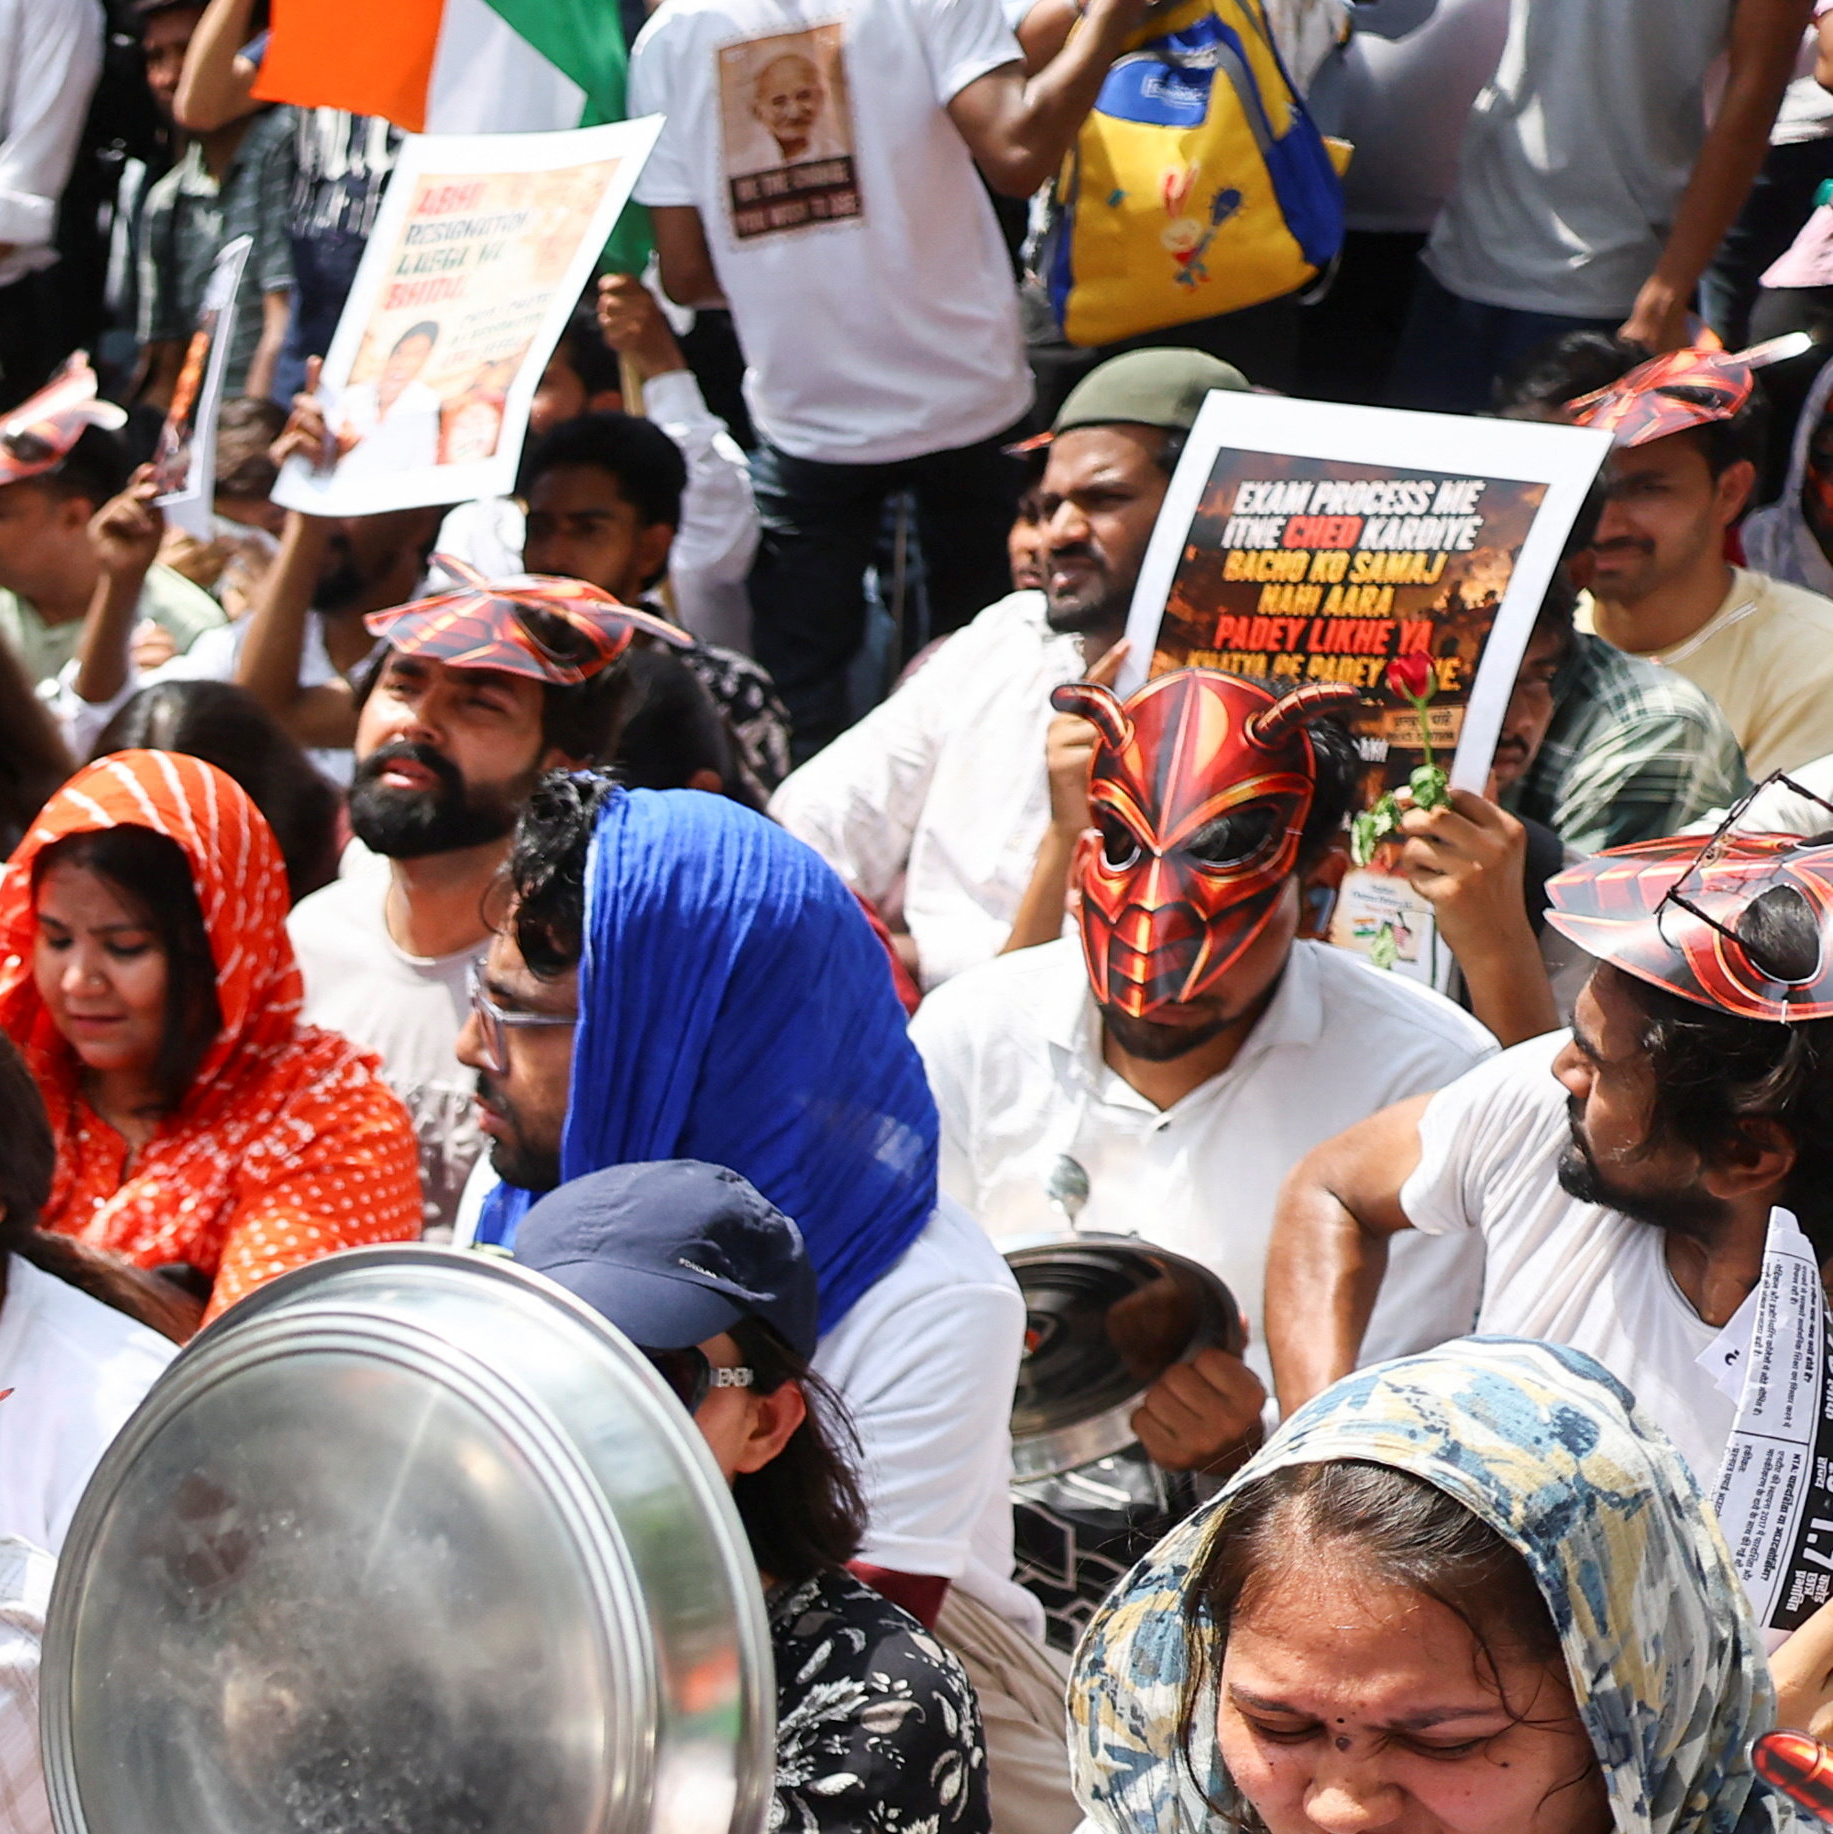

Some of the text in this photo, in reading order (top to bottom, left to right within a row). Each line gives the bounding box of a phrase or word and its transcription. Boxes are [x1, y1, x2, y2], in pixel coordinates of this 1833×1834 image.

[405, 210, 528, 246] RESIGNATION
[1233, 480, 1487, 515] EXAM PROCESS ME
[1221, 515, 1484, 551] ITNE CHED KARDIYE
[1223, 550, 1449, 584] BACHO KO SAMAJ
[1257, 583, 1396, 617] NAHI AARA
[1213, 615, 1434, 654] PADEY LIKHE YA
[1305, 654, 1388, 689] PADEY
[1772, 1450, 1788, 1473] एनटीए
[1788, 1452, 1803, 1474] NTA:
[1810, 1455, 1830, 1489] राज्य
[1769, 1473, 1781, 1485] की
[1750, 1496, 1761, 1510] दावे
[1754, 1487, 1764, 1496] के
[1762, 1485, 1777, 1509] स्थापना
[1748, 1510, 1758, 1519] के
[1757, 1510, 1770, 1528] 2017
[1776, 1514, 1786, 1525] या
[1743, 1520, 1754, 1534] साथ
[1740, 1535, 1751, 1547] की
[1801, 1516, 1833, 1570] 1.7
[1740, 1568, 1753, 1581] और
[1803, 1571, 1819, 1596] छात्र
[1784, 1568, 1809, 1613] प्रभावित
[1811, 1572, 1832, 1605] करोड़
